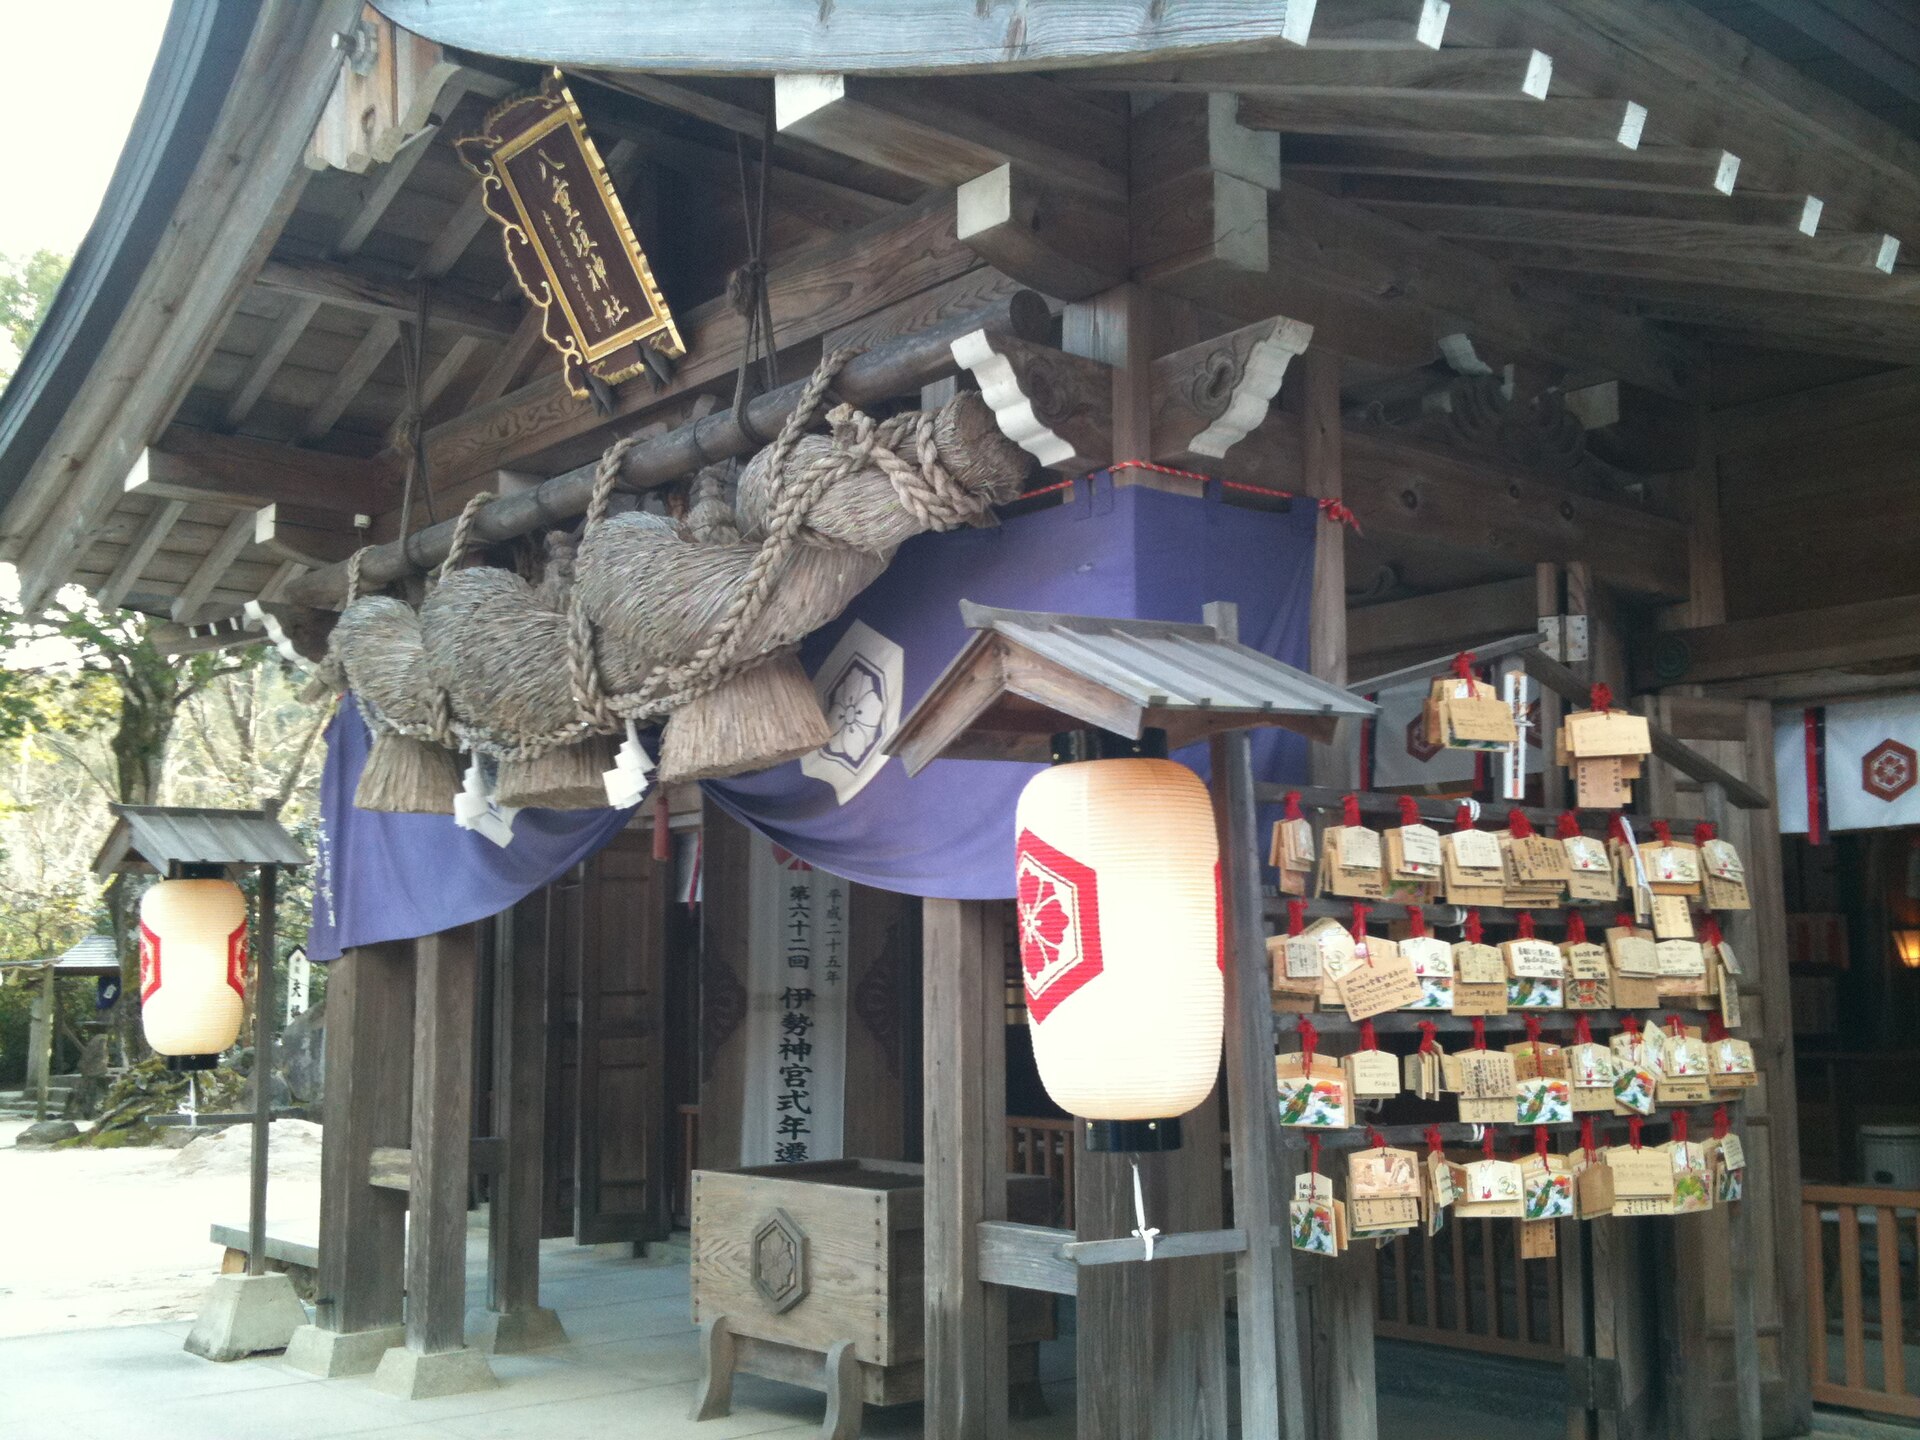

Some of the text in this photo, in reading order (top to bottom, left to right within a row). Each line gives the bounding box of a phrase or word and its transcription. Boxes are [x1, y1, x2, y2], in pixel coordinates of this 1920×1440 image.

[537, 148, 630, 329] 八重垣神社
[774, 885, 816, 1164] 第六十二回 伊勢神宮式年遷
[823, 887, 843, 986] 平成二十五年
